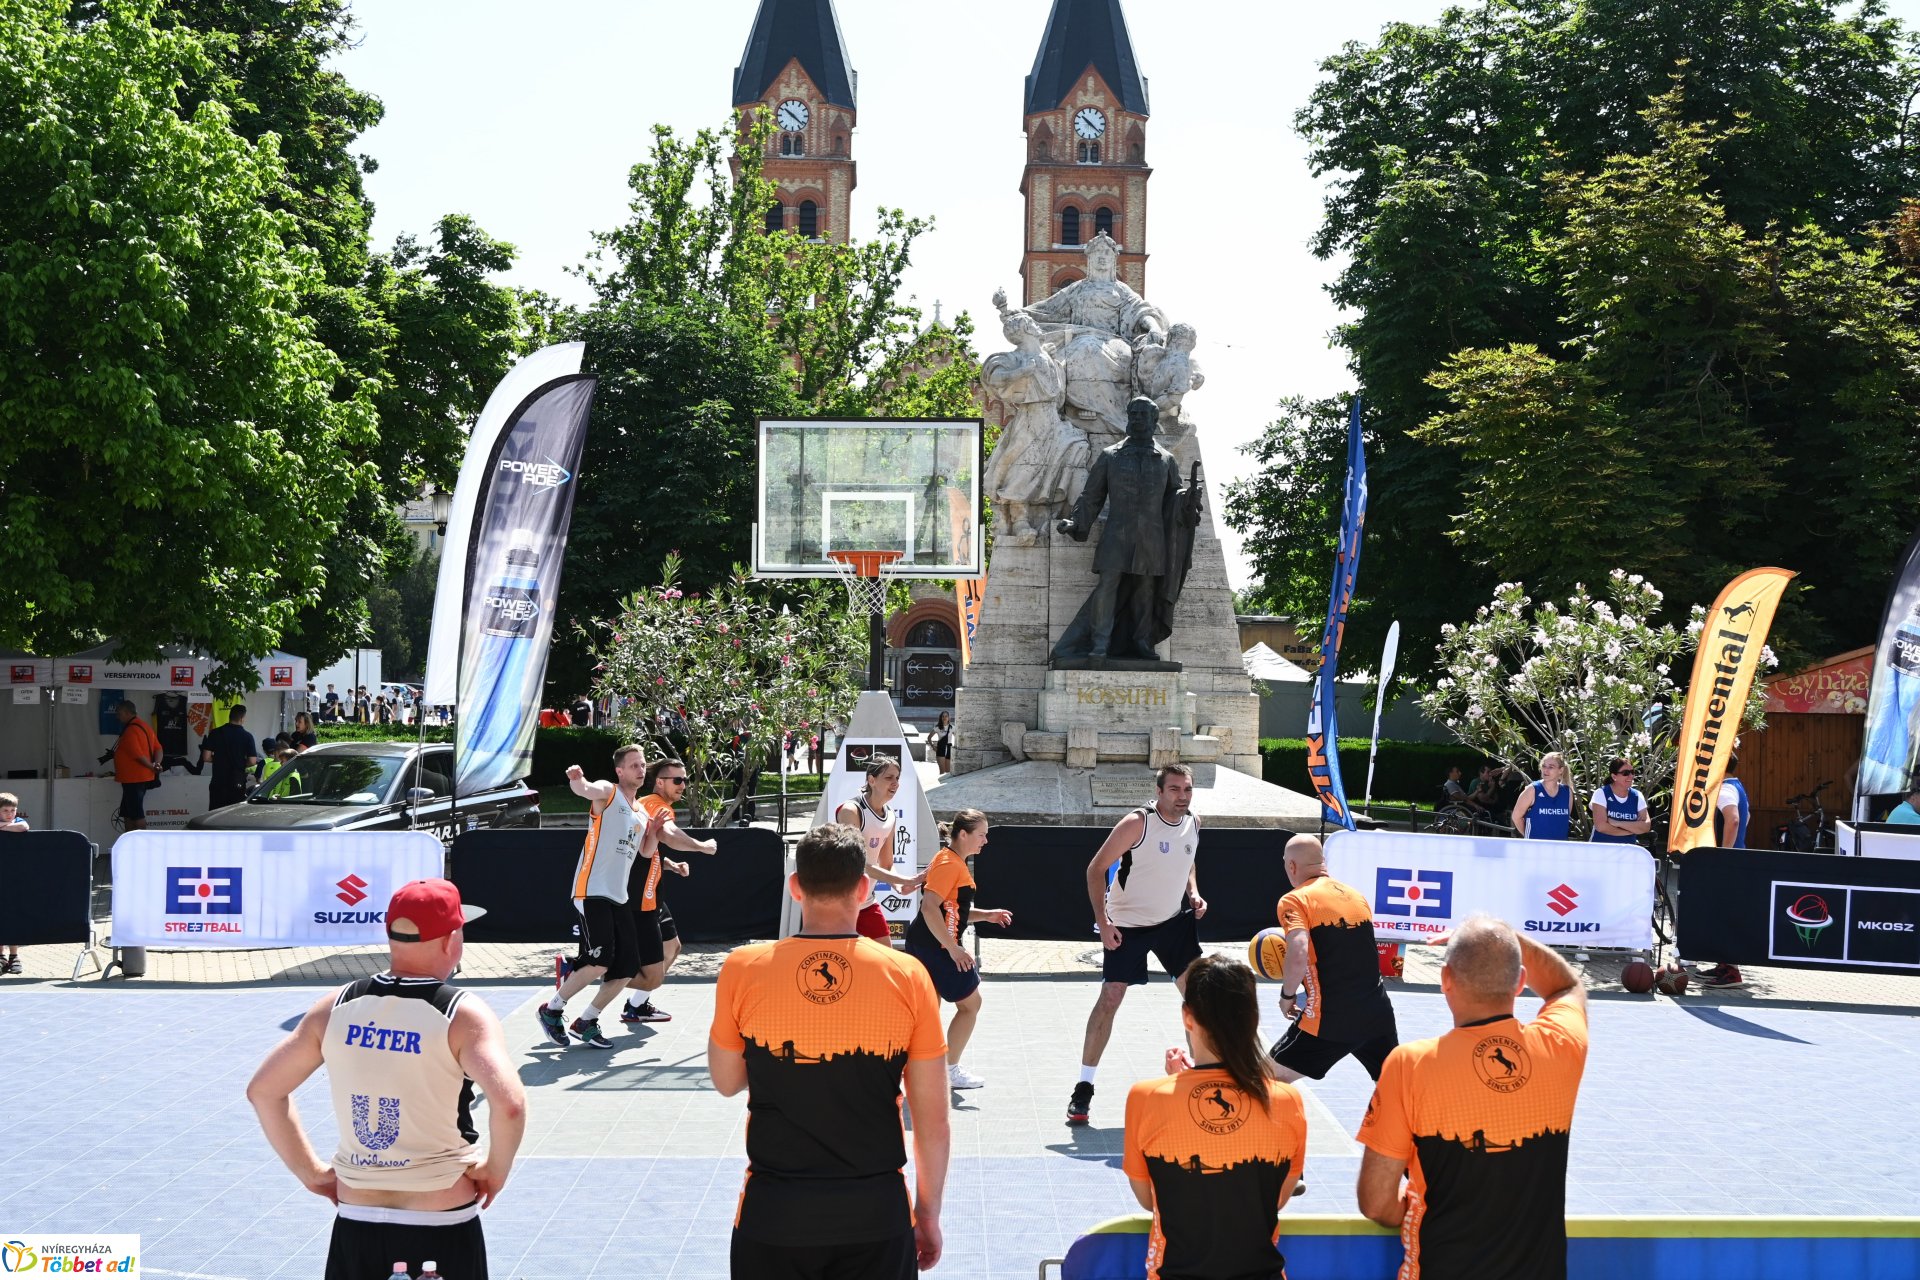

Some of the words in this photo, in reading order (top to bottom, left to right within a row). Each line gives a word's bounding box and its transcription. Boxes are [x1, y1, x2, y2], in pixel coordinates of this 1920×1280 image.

[500, 460, 560, 476] POWER
[522, 473, 558, 487] ADE
[483, 596, 532, 611] POWER
[500, 608, 531, 621] ADE
[1891, 637, 1920, 651] POWE
[1901, 651, 1920, 663] AD
[104, 672, 161, 680] VERSENYIRODA
[1077, 687, 1167, 705] KOSSUTH
[1683, 629, 1748, 828] Continental
[888, 898, 912, 909] TOTI
[164, 922, 242, 933] STREETBALL
[888, 923, 904, 934] OPS
[1524, 919, 1601, 932] SUZUKI
[1858, 920, 1915, 932] MKOSZ
[800, 952, 849, 971] CONTINENTAL
[804, 990, 827, 1003] SINCE
[828, 990, 843, 1002] 1871
[345, 1021, 422, 1055] PÉTER
[1475, 1037, 1522, 1058] CONTINENTAL
[1486, 1079, 1509, 1092] SINCE
[1511, 1075, 1527, 1088] 1871
[1200, 1120, 1225, 1133] SINCE
[1226, 1117, 1243, 1131] 1871
[350, 1153, 411, 1168] Unilever
